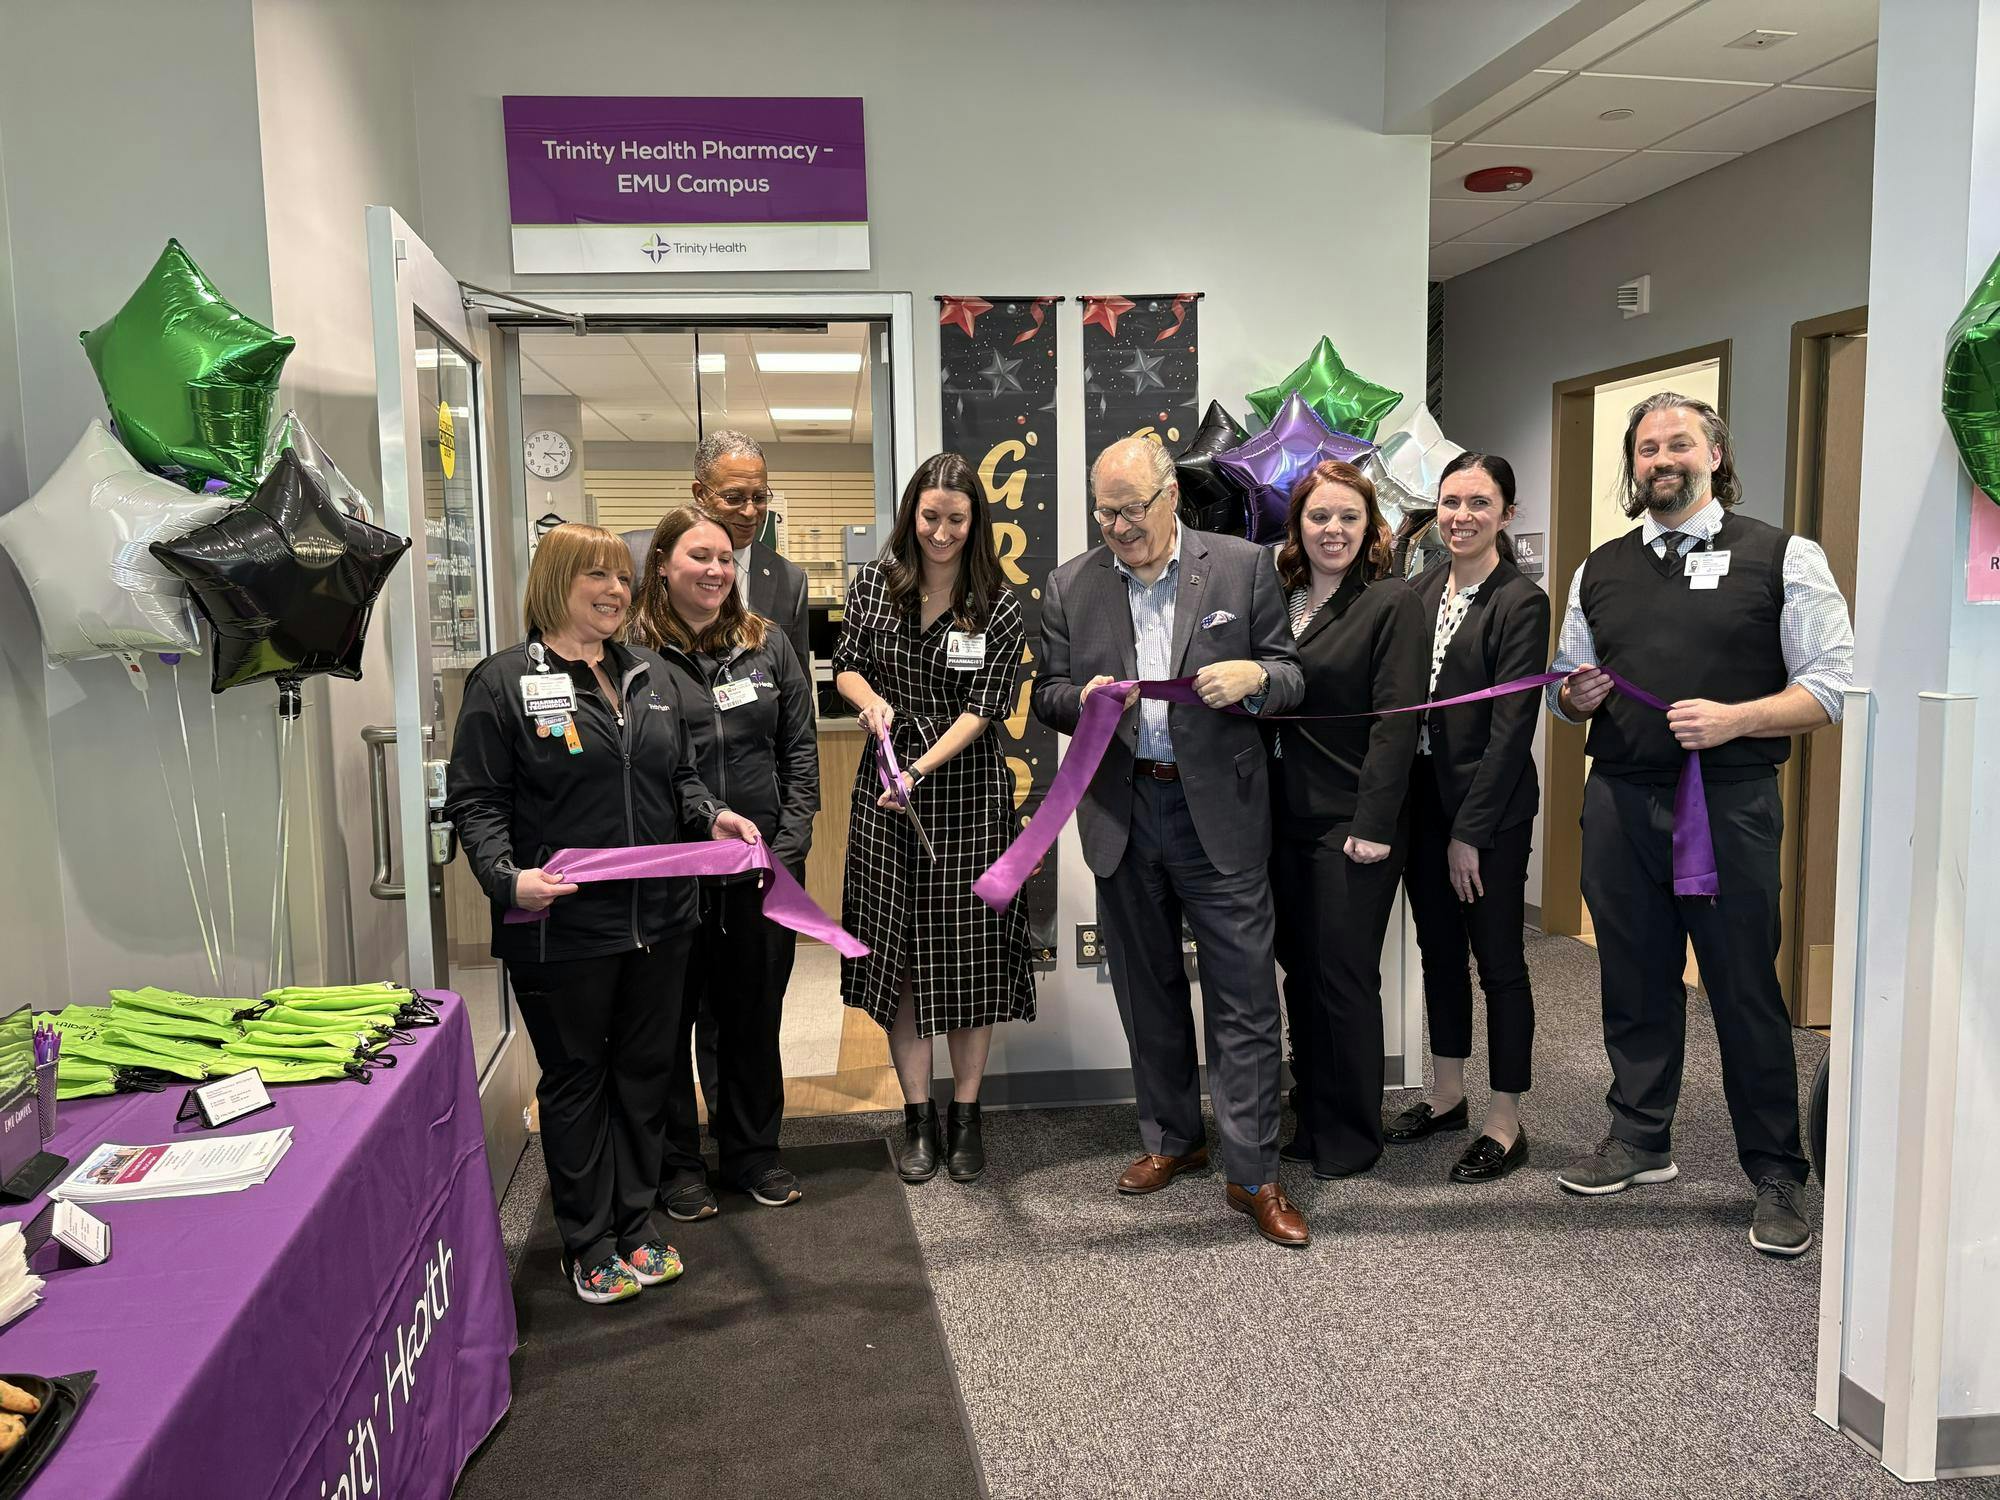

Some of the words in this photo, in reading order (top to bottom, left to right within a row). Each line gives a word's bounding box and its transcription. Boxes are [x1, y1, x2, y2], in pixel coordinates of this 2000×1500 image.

[541, 140, 615, 164] Trinity
[621, 140, 697, 160] Health
[702, 140, 818, 164] Pharmacy
[617, 174, 671, 193] EMU
[677, 173, 770, 197] Campus
[673, 242, 707, 255] Trinity
[709, 242, 747, 253] Health
[529, 703, 571, 711] TECHNICIAN
[530, 698, 568, 706] PHARMACY
[385, 1238, 456, 1435] Health
